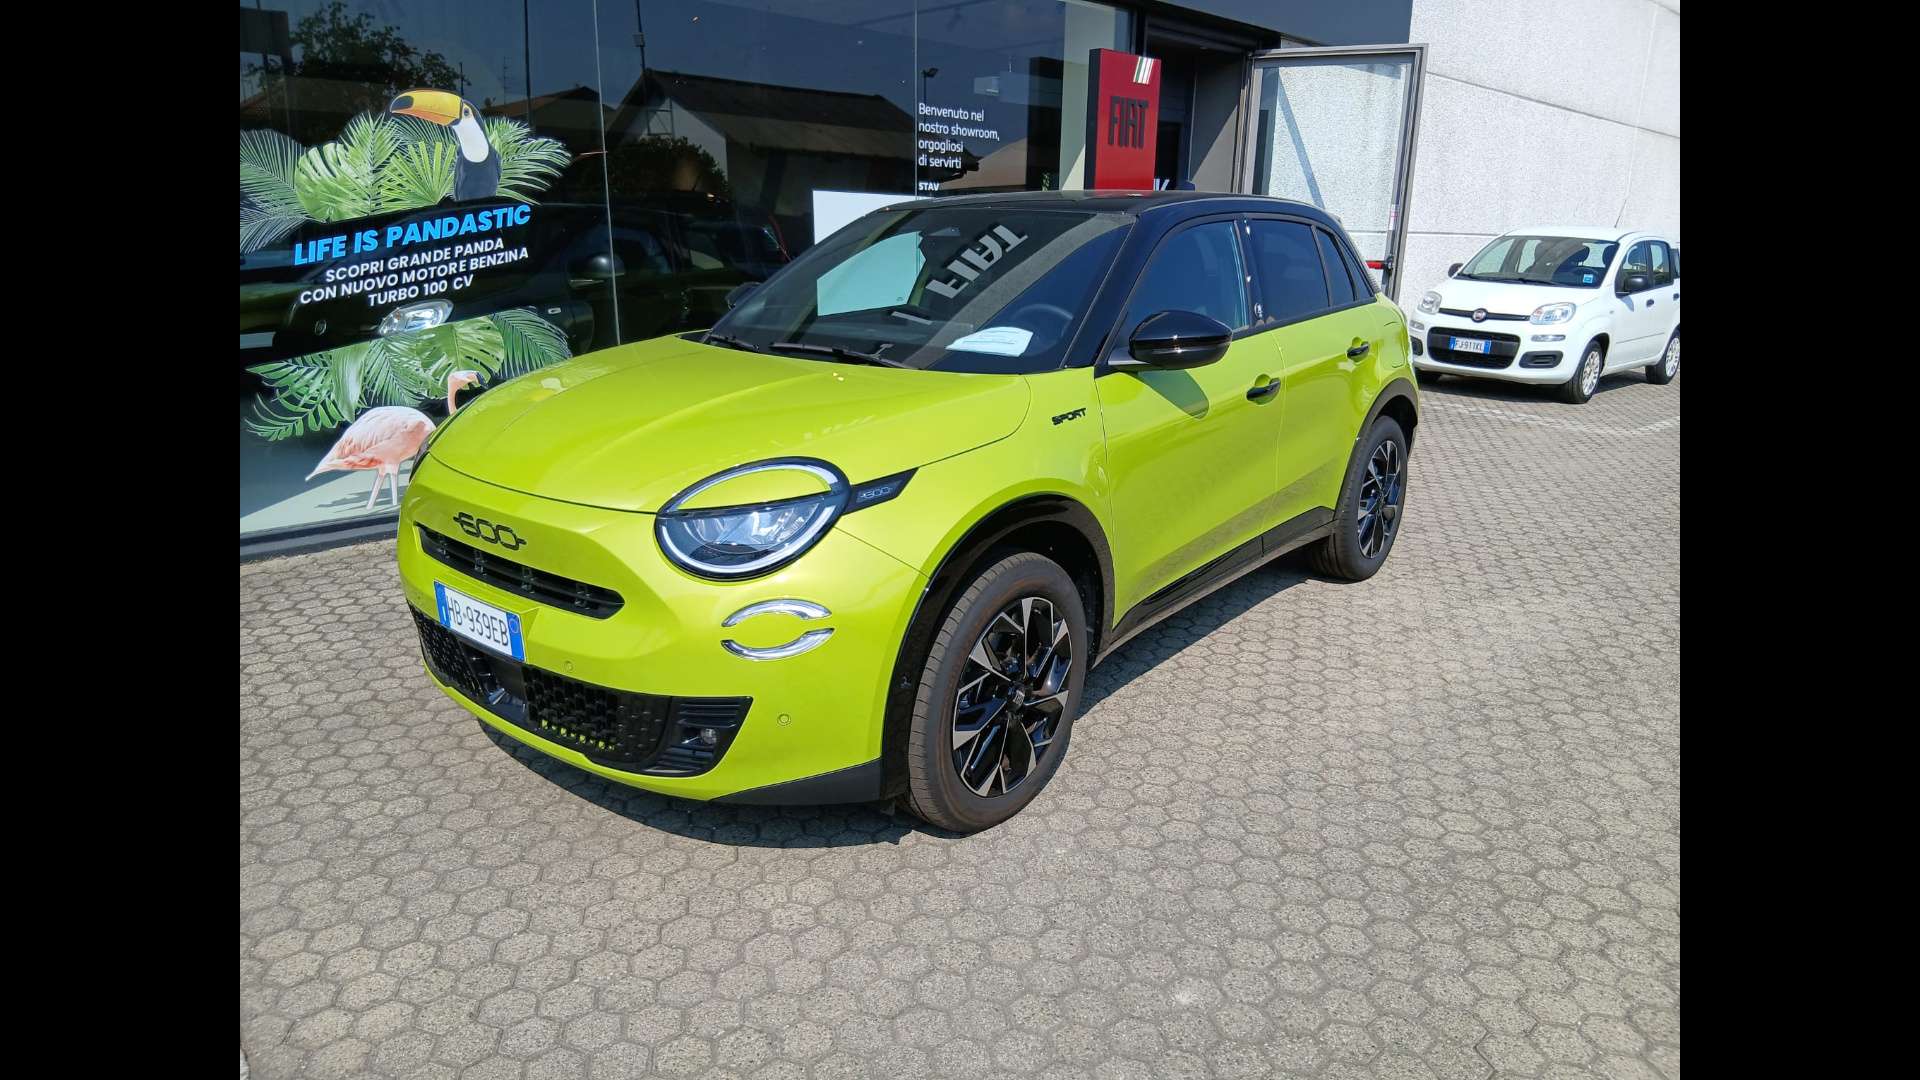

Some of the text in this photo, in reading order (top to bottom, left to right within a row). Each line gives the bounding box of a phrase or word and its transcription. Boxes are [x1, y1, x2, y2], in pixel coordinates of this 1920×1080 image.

[918, 102, 984, 122] Benvenuto nel
[918, 122, 1000, 141] nostro showroom,
[1108, 96, 1149, 150] FIAT
[918, 139, 964, 154] orgogliosi
[918, 154, 962, 169] di servirti
[918, 182, 940, 192] STAV
[294, 204, 532, 266] LIFE IS PANDASTIC
[325, 237, 505, 283] SCOPRI GRANDE PANDA
[300, 247, 529, 304] CON NUOVO MOTORE BENZINA
[368, 273, 474, 307] TURBO 100 CV
[1051, 407, 1087, 426] SPORT
